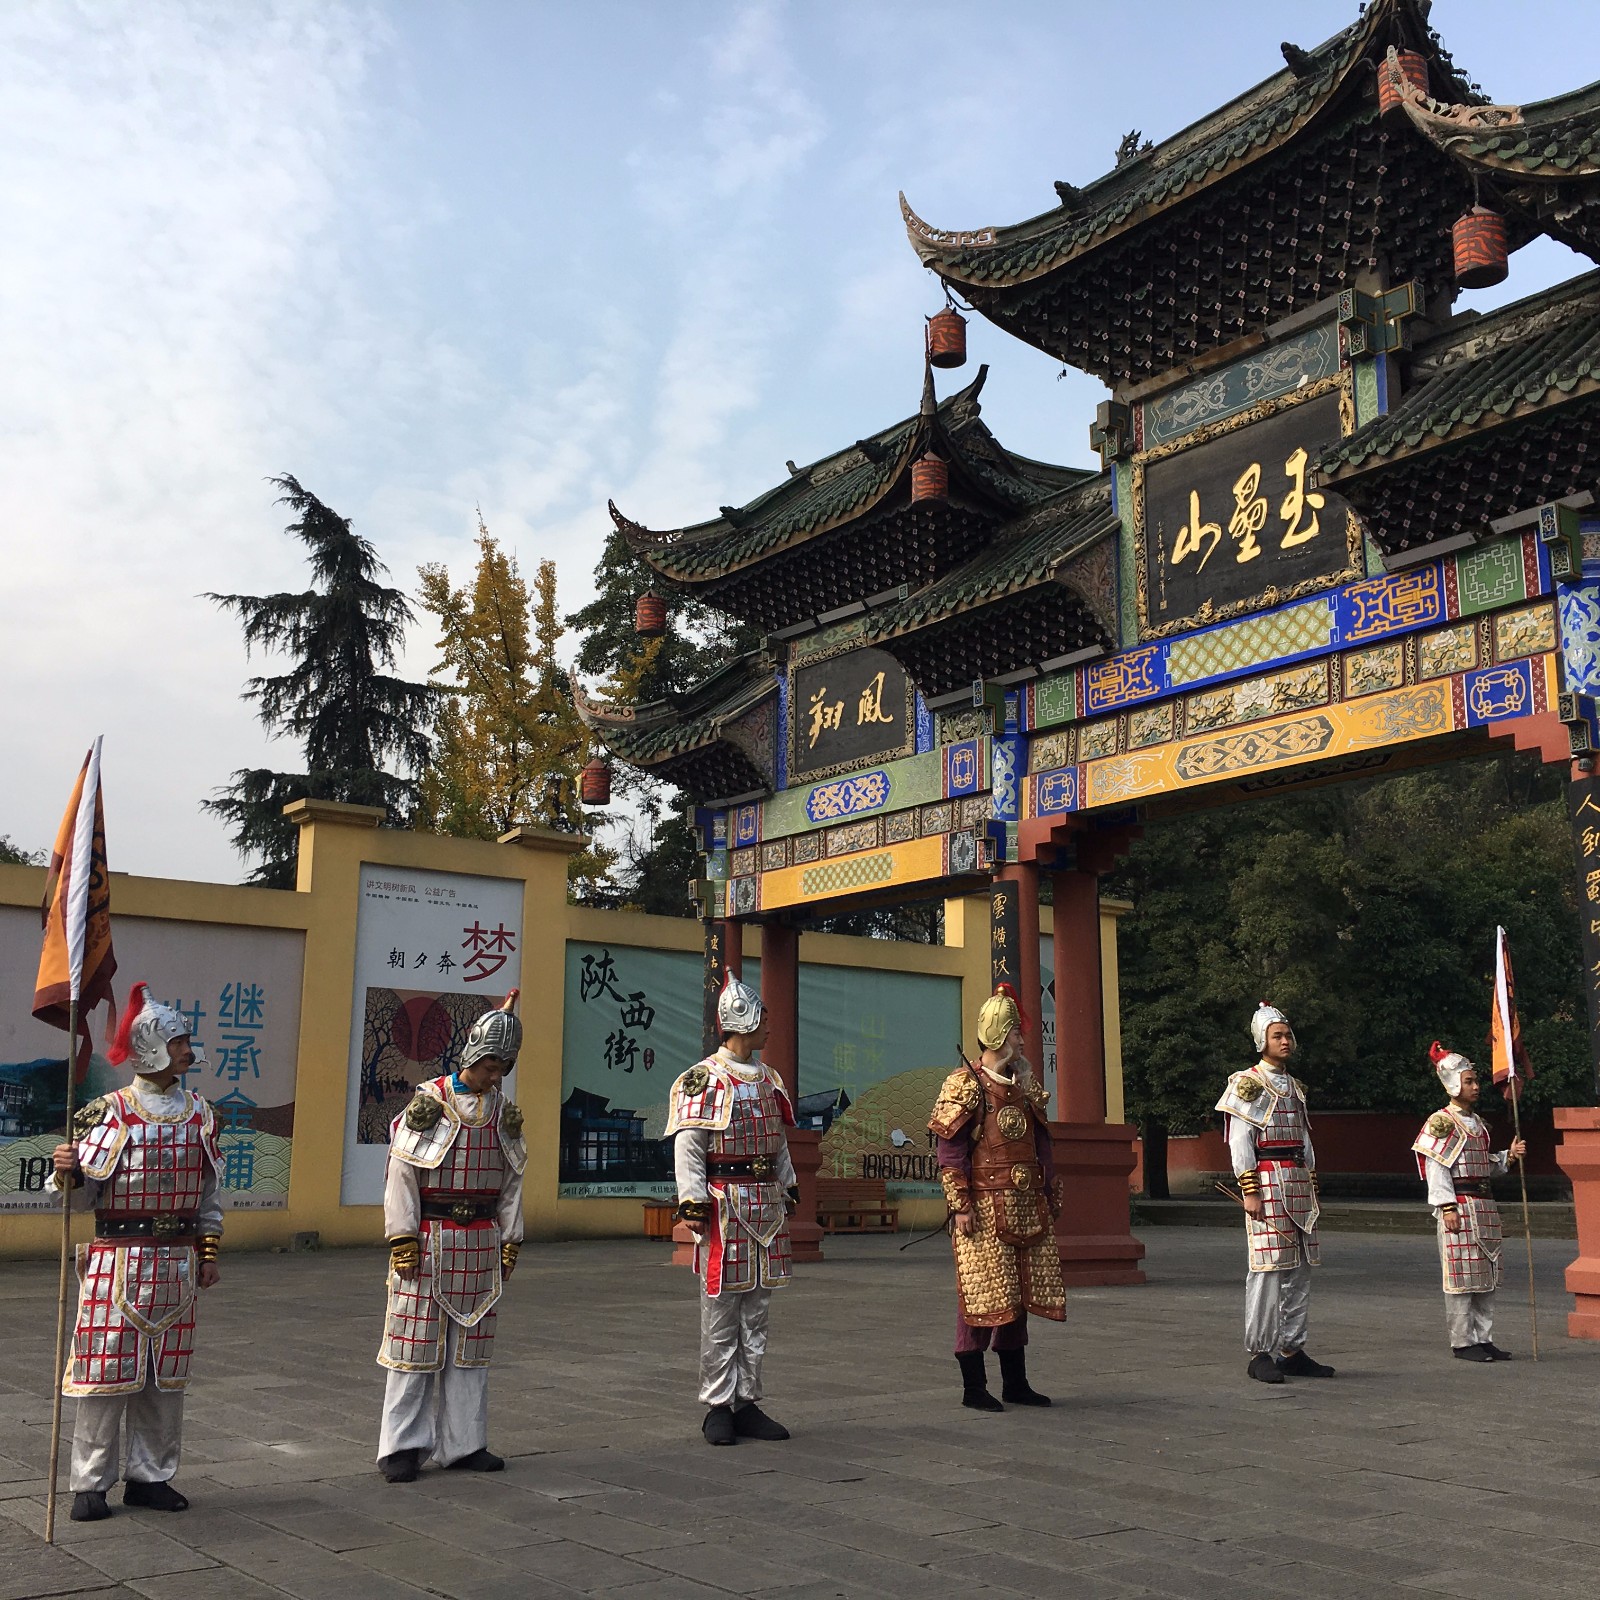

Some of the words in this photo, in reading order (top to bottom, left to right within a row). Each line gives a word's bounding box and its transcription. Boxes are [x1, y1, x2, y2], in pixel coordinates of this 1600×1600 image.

[366, 879, 417, 894] 讲文明树新风
[424, 886, 457, 898] 公益广告
[387, 920, 517, 983] 朝夕奔梦
